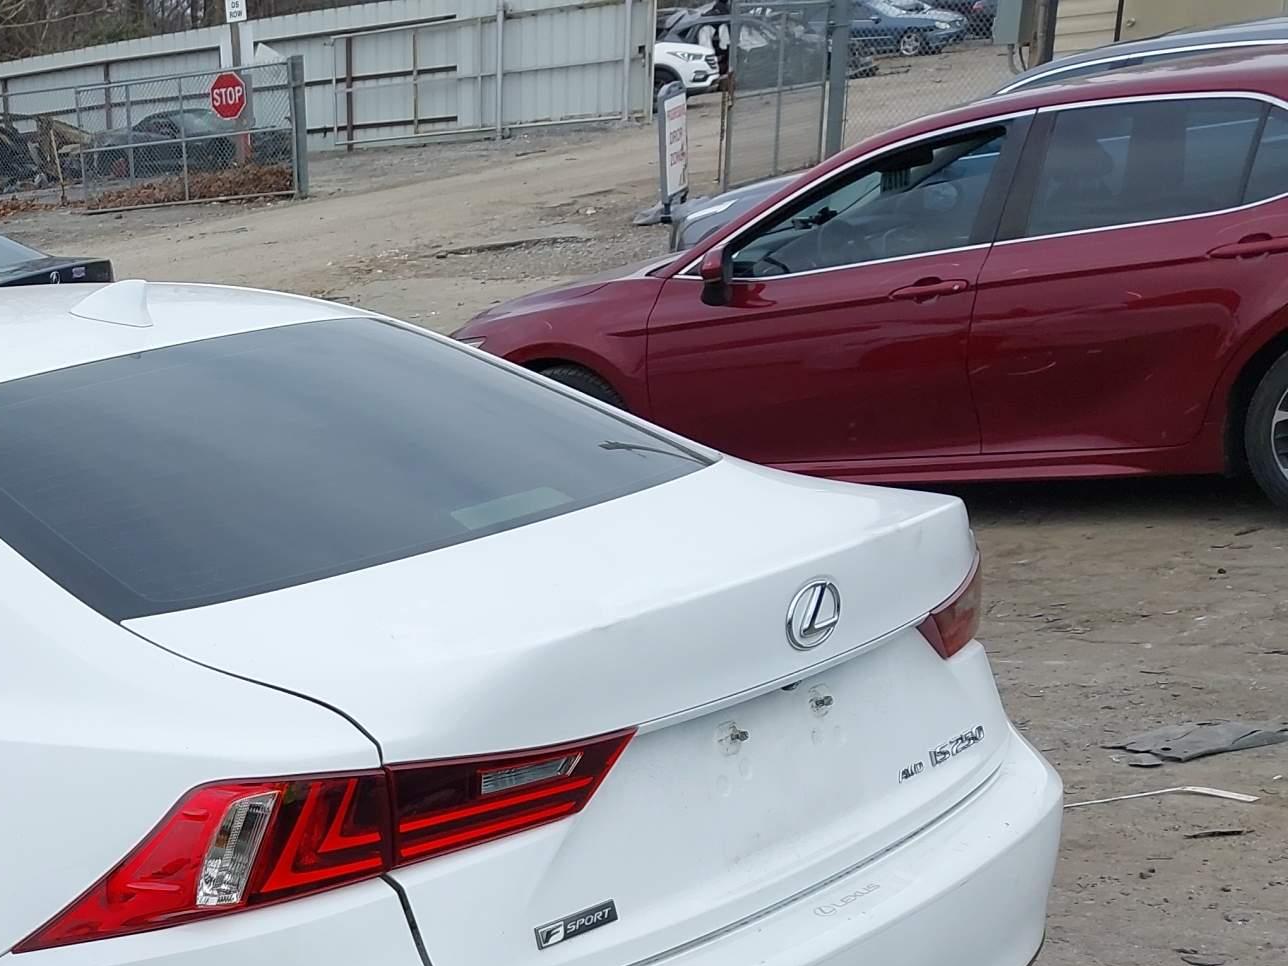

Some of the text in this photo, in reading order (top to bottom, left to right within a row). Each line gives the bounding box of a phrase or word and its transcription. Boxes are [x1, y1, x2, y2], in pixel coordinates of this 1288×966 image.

[213, 86, 243, 106] STOP
[898, 761, 924, 784] AWD
[831, 884, 881, 908] LEXUS
[566, 907, 612, 934] SPORT
